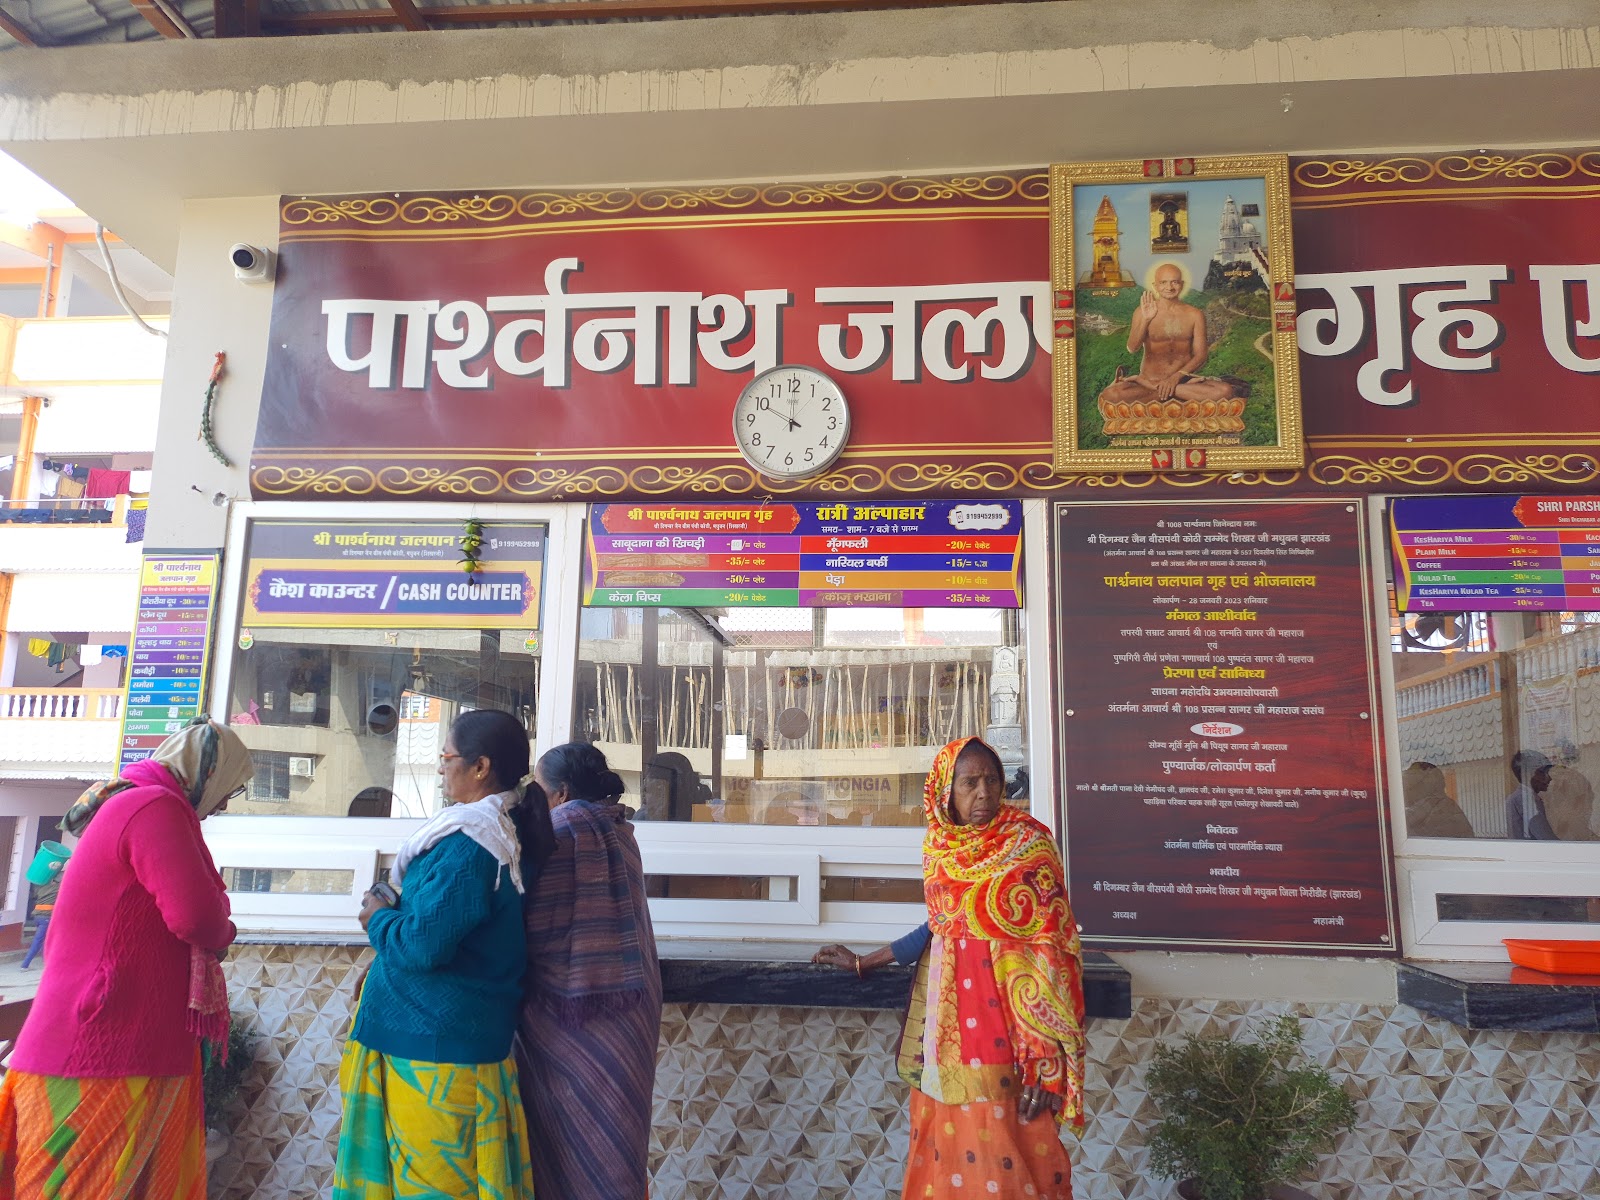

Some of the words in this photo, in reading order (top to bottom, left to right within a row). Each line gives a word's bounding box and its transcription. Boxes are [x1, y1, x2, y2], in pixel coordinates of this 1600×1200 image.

[321, 257, 788, 388] पार्श्वनाथ
[770, 384, 782, 398] 11
[810, 384, 815, 398] 1
[787, 379, 801, 393] 12
[755, 397, 770, 410] 10
[822, 398, 831, 411] 2
[747, 414, 756, 427] 9
[827, 416, 837, 430] 3
[752, 433, 761, 446] 8
[819, 435, 828, 448] 4
[767, 446, 775, 459] 7
[804, 448, 813, 461] 5
[784, 452, 793, 465] 6
[853, 506, 926, 521] अल्पाहार
[1537, 501, 1563, 512] SHRI
[627, 508, 643, 521] श्री
[703, 510, 751, 521] जलपान
[754, 510, 773, 523] गृह
[313, 531, 332, 546] श्री
[400, 535, 456, 547] जलपान
[655, 537, 670, 548] की
[672, 537, 705, 550] खिचड़ी
[1087, 533, 1096, 543] श्री
[1131, 533, 1146, 543] जैन
[1182, 532, 1201, 543] कोठी
[1231, 532, 1255, 543] शिखर
[1258, 532, 1269, 543] जी
[153, 562, 164, 572] श्री
[1157, 576, 1203, 588] जलपान
[1207, 576, 1227, 591] गृह
[1230, 572, 1249, 587] एवं
[1253, 572, 1316, 588] भोजनालय
[269, 577, 307, 598] कैश
[398, 583, 441, 601] CASH
[446, 583, 522, 601] COUNTER
[608, 590, 633, 602] केला
[636, 590, 661, 602] चिप्स
[1165, 608, 1201, 621] मंगल
[1203, 608, 1257, 621] आशीर्वाद
[1204, 629, 1216, 637] 108
[1265, 627, 1276, 637] जी
[1163, 666, 1195, 679] प्रेरणा
[1197, 665, 1217, 679] एवं
[1171, 702, 1181, 713] श्री
[1184, 705, 1198, 713] 108
[1228, 705, 1251, 714] सागर
[1253, 703, 1265, 714] जी
